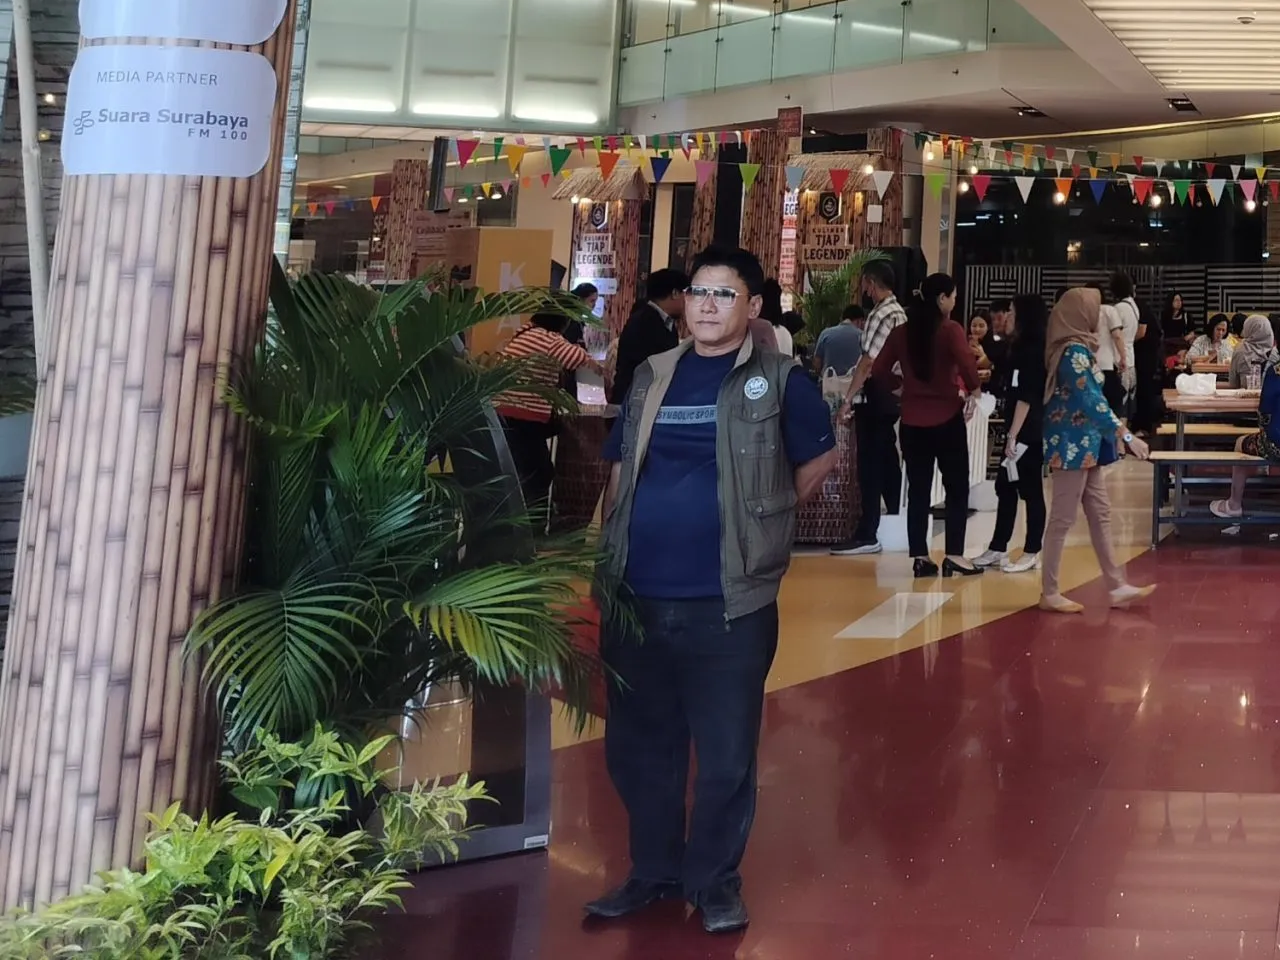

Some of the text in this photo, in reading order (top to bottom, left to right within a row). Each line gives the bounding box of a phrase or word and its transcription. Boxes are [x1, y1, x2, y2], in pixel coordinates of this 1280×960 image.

[96, 71, 218, 86] MEDIA PARTNER
[98, 108, 249, 131] Suara Surabaya
[587, 242, 605, 253] TJAP
[815, 234, 840, 248] TJAP
[577, 254, 613, 264] LEGENDE
